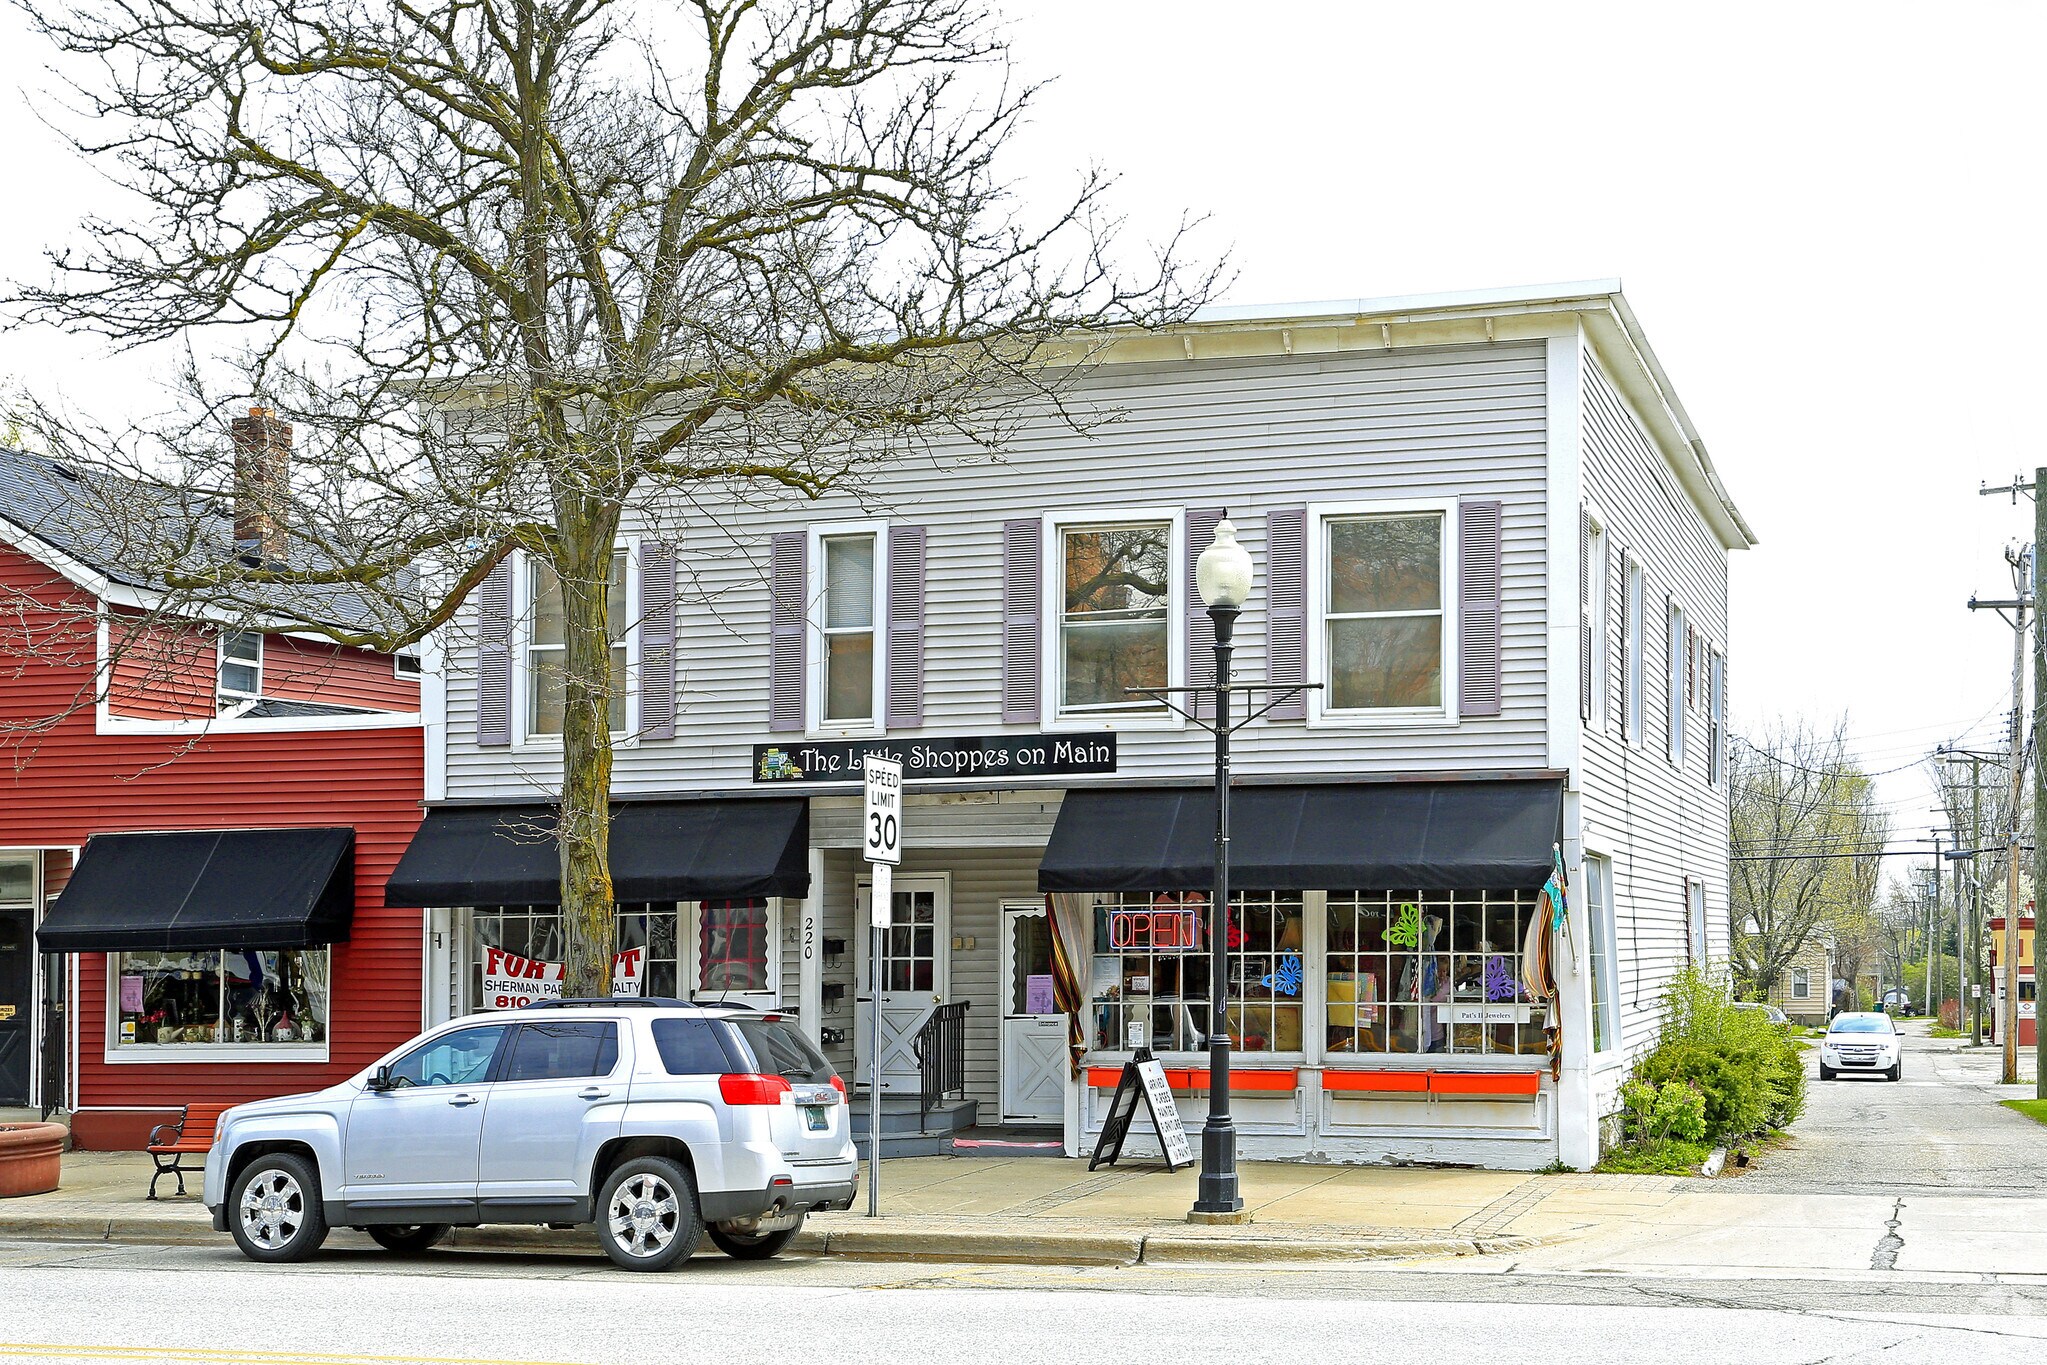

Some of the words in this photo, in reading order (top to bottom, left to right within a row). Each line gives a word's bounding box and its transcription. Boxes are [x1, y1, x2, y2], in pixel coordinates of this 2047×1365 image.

[800, 748, 841, 773] The
[908, 745, 1010, 773] Shoppes
[1016, 747, 1046, 765] on
[1053, 741, 1110, 764] Main
[868, 769, 899, 788] SPEED
[871, 790, 895, 808] LIMIT
[868, 812, 897, 850] 30
[804, 917, 813, 960] 220
[1112, 914, 1193, 946] OPEN
[486, 947, 547, 980] FOR
[484, 980, 540, 994] SHERMAN
[1154, 1091, 1171, 1104] PURSES
